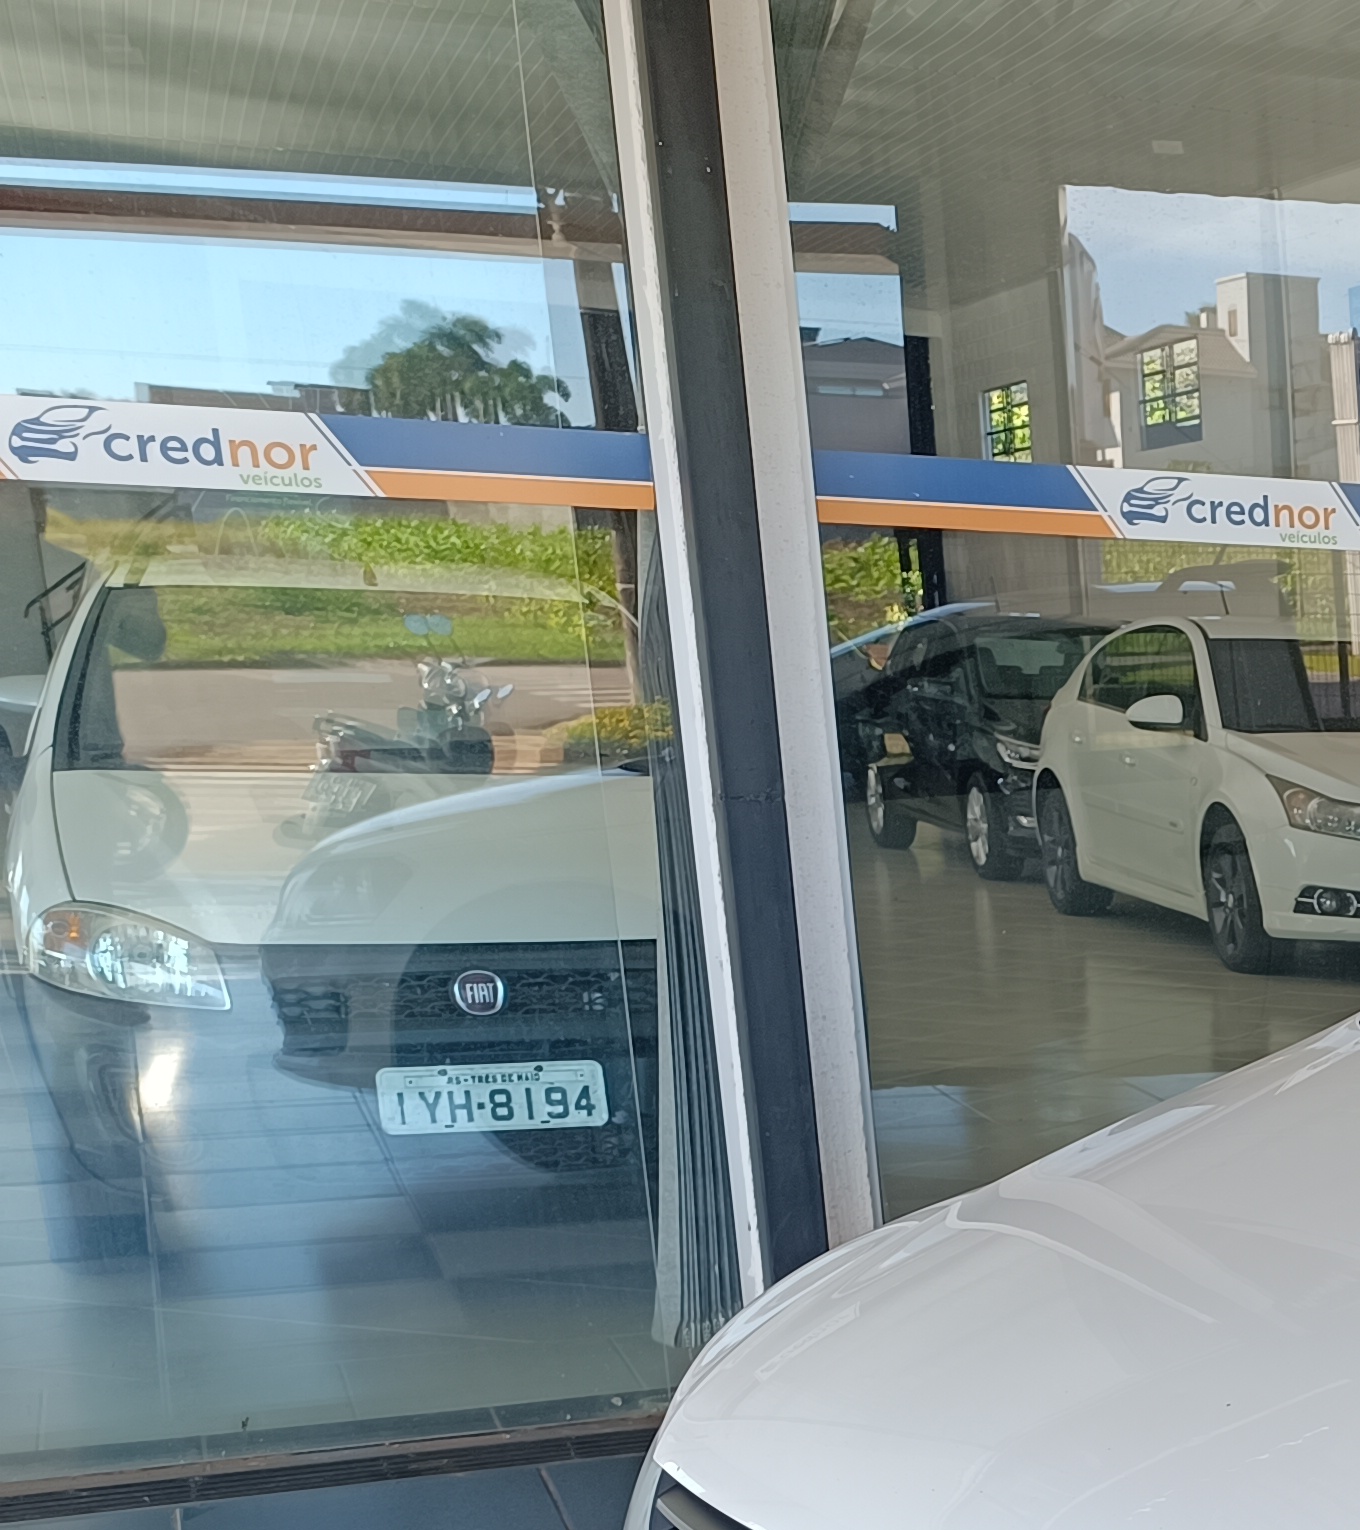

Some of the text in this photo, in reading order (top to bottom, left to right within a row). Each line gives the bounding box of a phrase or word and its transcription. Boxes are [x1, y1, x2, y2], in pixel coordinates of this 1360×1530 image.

[103, 427, 318, 471] crednor
[239, 472, 323, 489] veículos
[1186, 494, 1336, 531] crednor
[1279, 532, 1338, 545] veículos
[465, 983, 495, 1004] FIAT
[396, 1085, 597, 1126] IYH-8194
